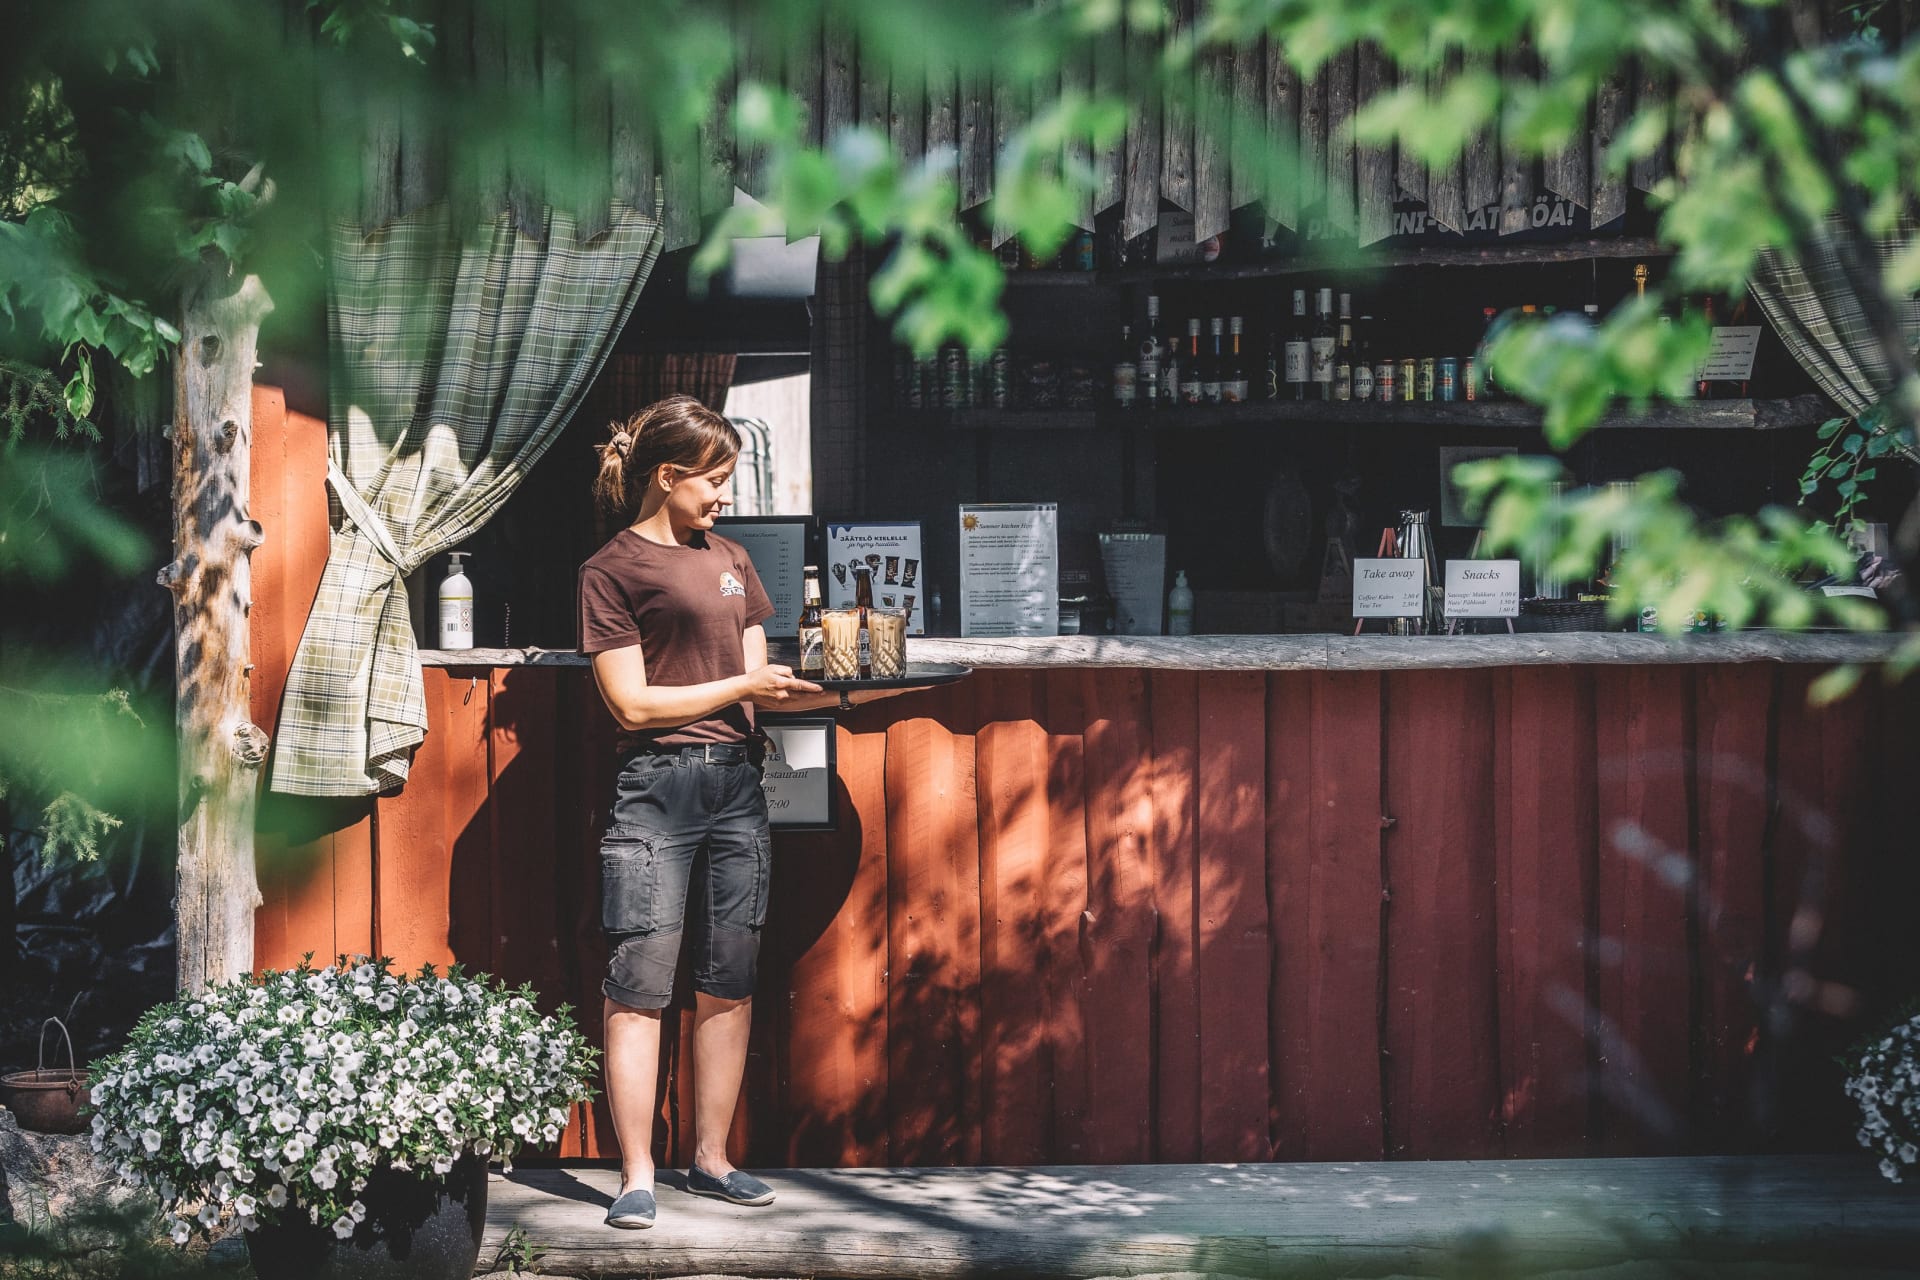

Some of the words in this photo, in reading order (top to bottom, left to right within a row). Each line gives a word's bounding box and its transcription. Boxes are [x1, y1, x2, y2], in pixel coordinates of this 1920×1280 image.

[1363, 569, 1387, 579] Take
[1388, 570, 1415, 580] away
[1462, 569, 1501, 580] Snacks
[764, 769, 808, 779] estaurant
[766, 799, 790, 809] 7:00
